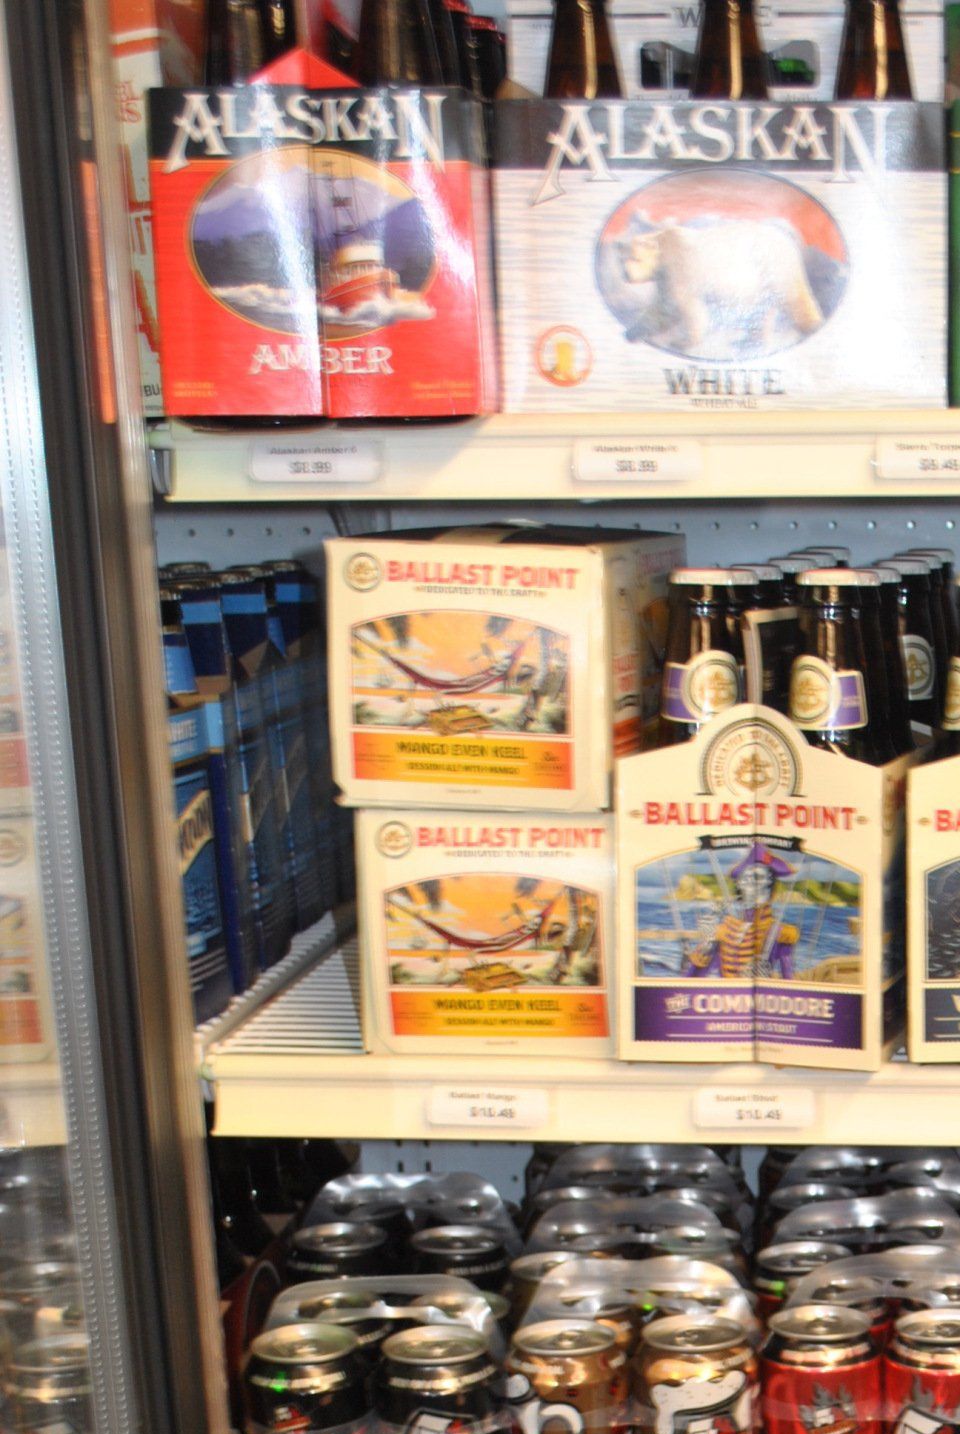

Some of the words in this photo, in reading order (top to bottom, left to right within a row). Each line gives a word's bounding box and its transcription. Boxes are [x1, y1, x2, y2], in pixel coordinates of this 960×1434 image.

[162, 91, 447, 174] ALASKAN
[531, 104, 893, 207] ALASKAN
[247, 343, 395, 376] AMBER
[662, 366, 787, 396] WHITE
[385, 560, 494, 587] BALLAST
[501, 564, 579, 589] POINT
[642, 801, 768, 827] BALLAST
[776, 804, 856, 831] POINT
[416, 826, 522, 848] BALLAST
[527, 827, 606, 848] POINT
[692, 992, 835, 1019] COMMODORE
